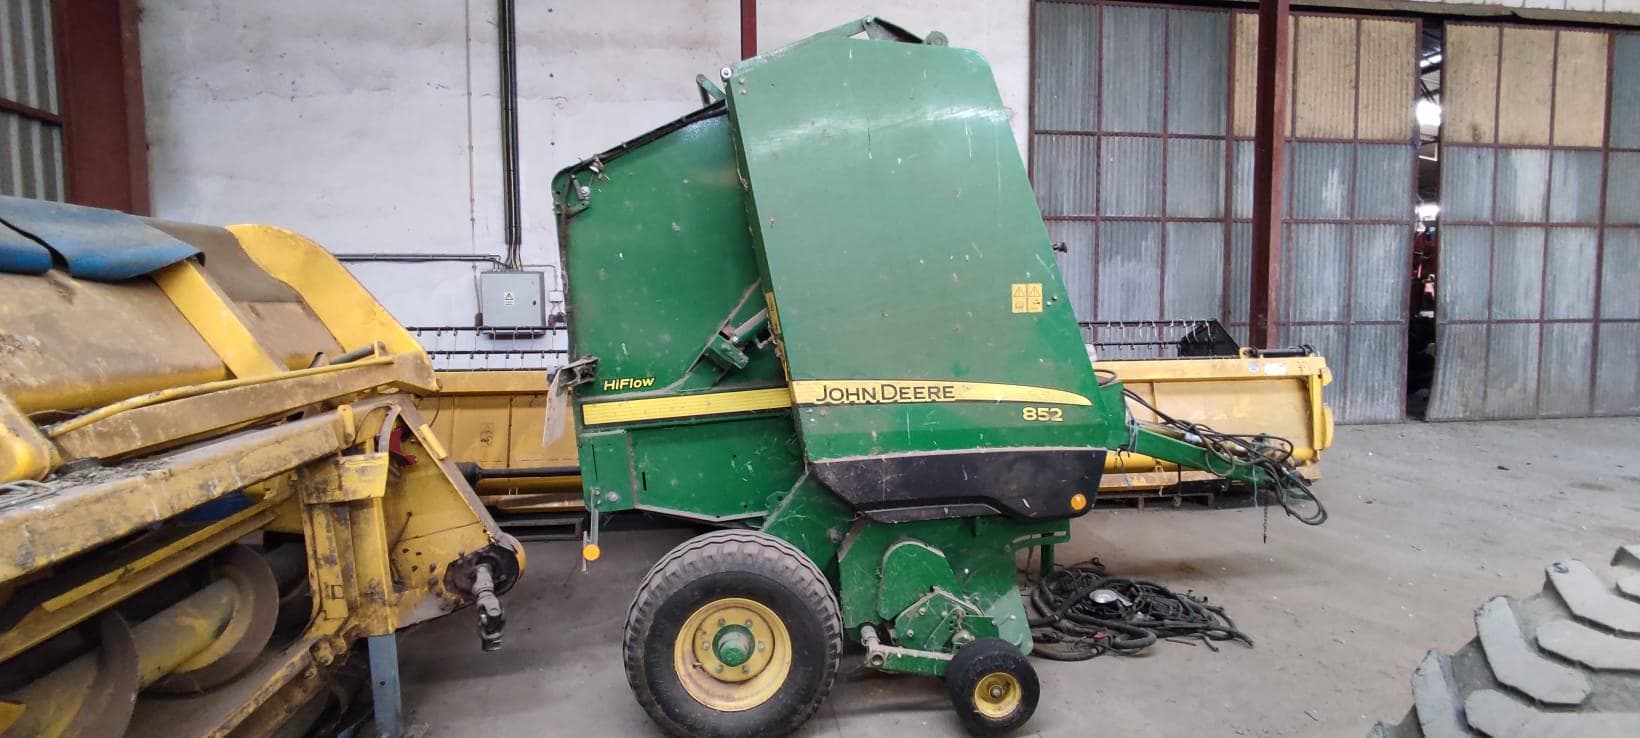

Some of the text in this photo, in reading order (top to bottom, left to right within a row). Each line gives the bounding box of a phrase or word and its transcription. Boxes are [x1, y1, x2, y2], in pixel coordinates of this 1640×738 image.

[603, 377, 655, 391] HiFlow
[815, 383, 956, 402] JOHN DEERE
[1022, 406, 1063, 421] 852
